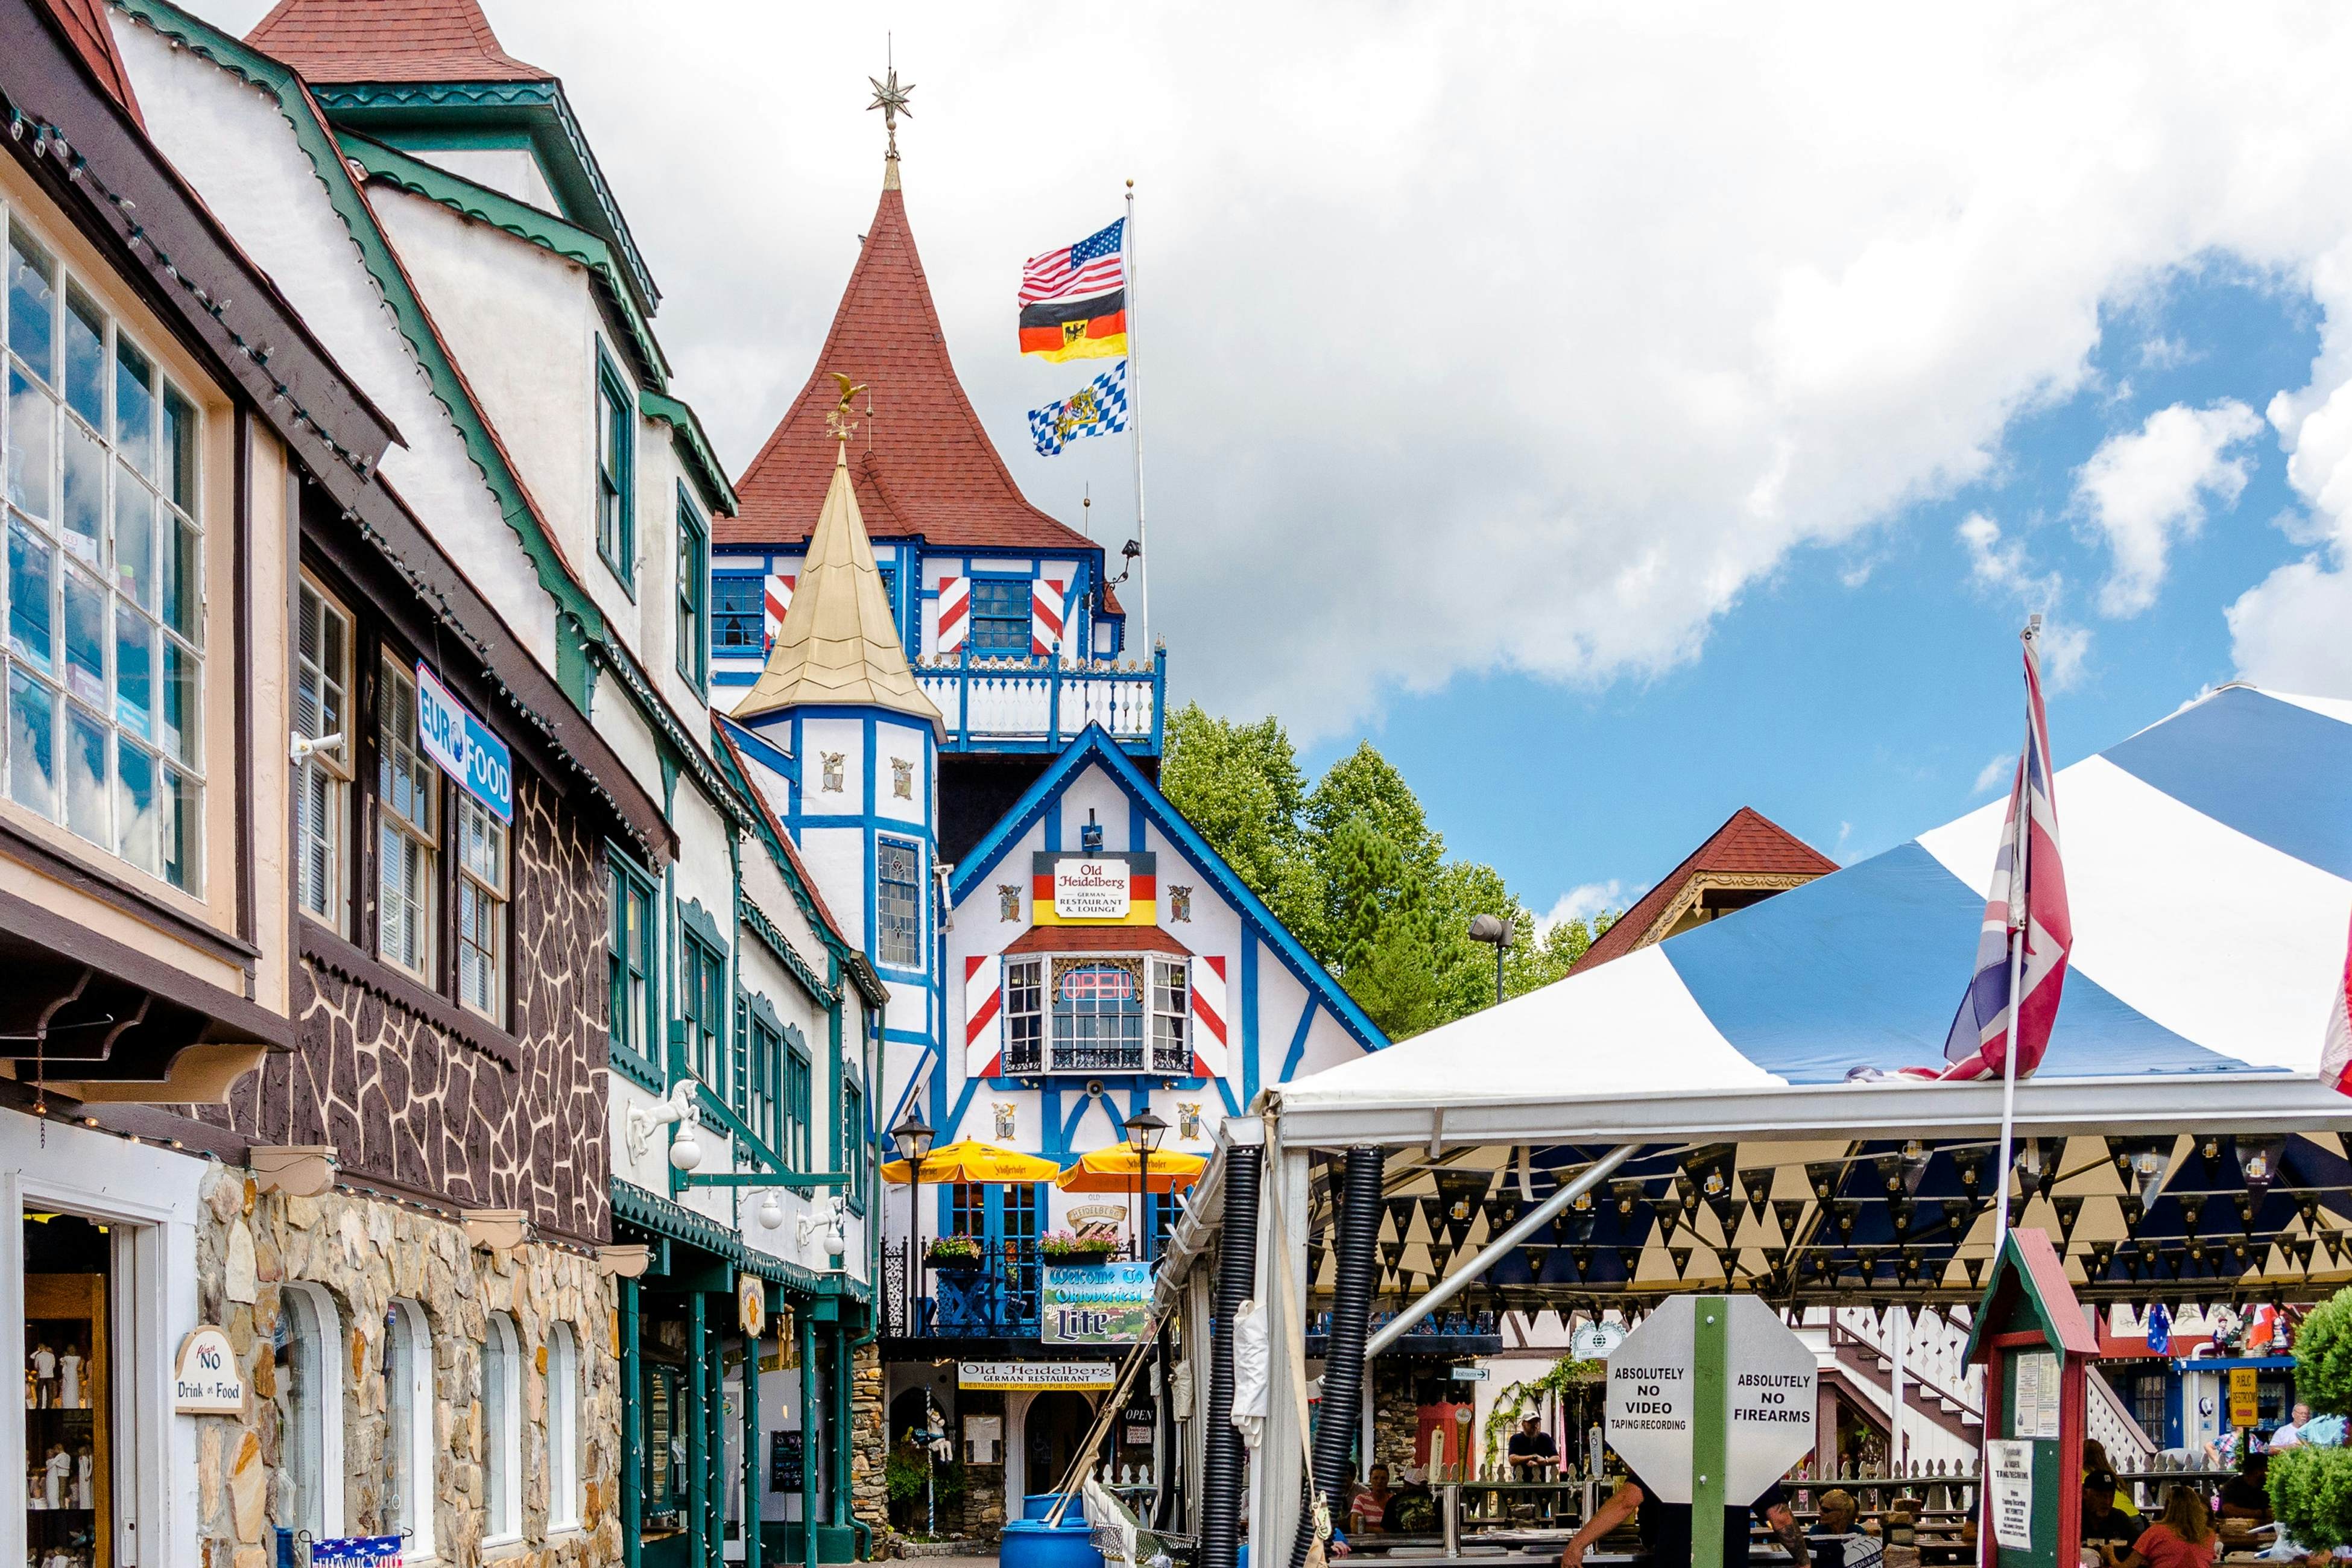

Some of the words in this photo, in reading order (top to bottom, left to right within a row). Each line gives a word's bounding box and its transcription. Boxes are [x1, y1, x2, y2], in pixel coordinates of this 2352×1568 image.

[466, 733, 510, 804] FOOD
[1081, 864, 1102, 875] Old
[1059, 876, 1124, 889] Heidelberg
[1065, 973, 1130, 998] OPEN
[1073, 1207, 1119, 1218] HEIDELBERG
[1049, 1268, 1115, 1285] Welcome
[1122, 1267, 1144, 1284] To
[1055, 1287, 1142, 1303] Oktoberfest
[1055, 1309, 1109, 1341] Lite
[201, 1352, 220, 1370] NO
[963, 1364, 996, 1374] Old
[1004, 1365, 1111, 1377] Heidelberg
[1615, 1368, 1684, 1380] ABSOLUTELY
[1738, 1374, 1810, 1388] ABSOLUTELY
[179, 1381, 203, 1397] Drink
[216, 1382, 239, 1399] Food
[1637, 1385, 1660, 1396] NO
[1761, 1393, 1785, 1404] NO
[1126, 1409, 1153, 1420] OPEN
[1626, 1402, 1672, 1414] VIDEO
[1734, 1409, 1810, 1423] FIREARMS
